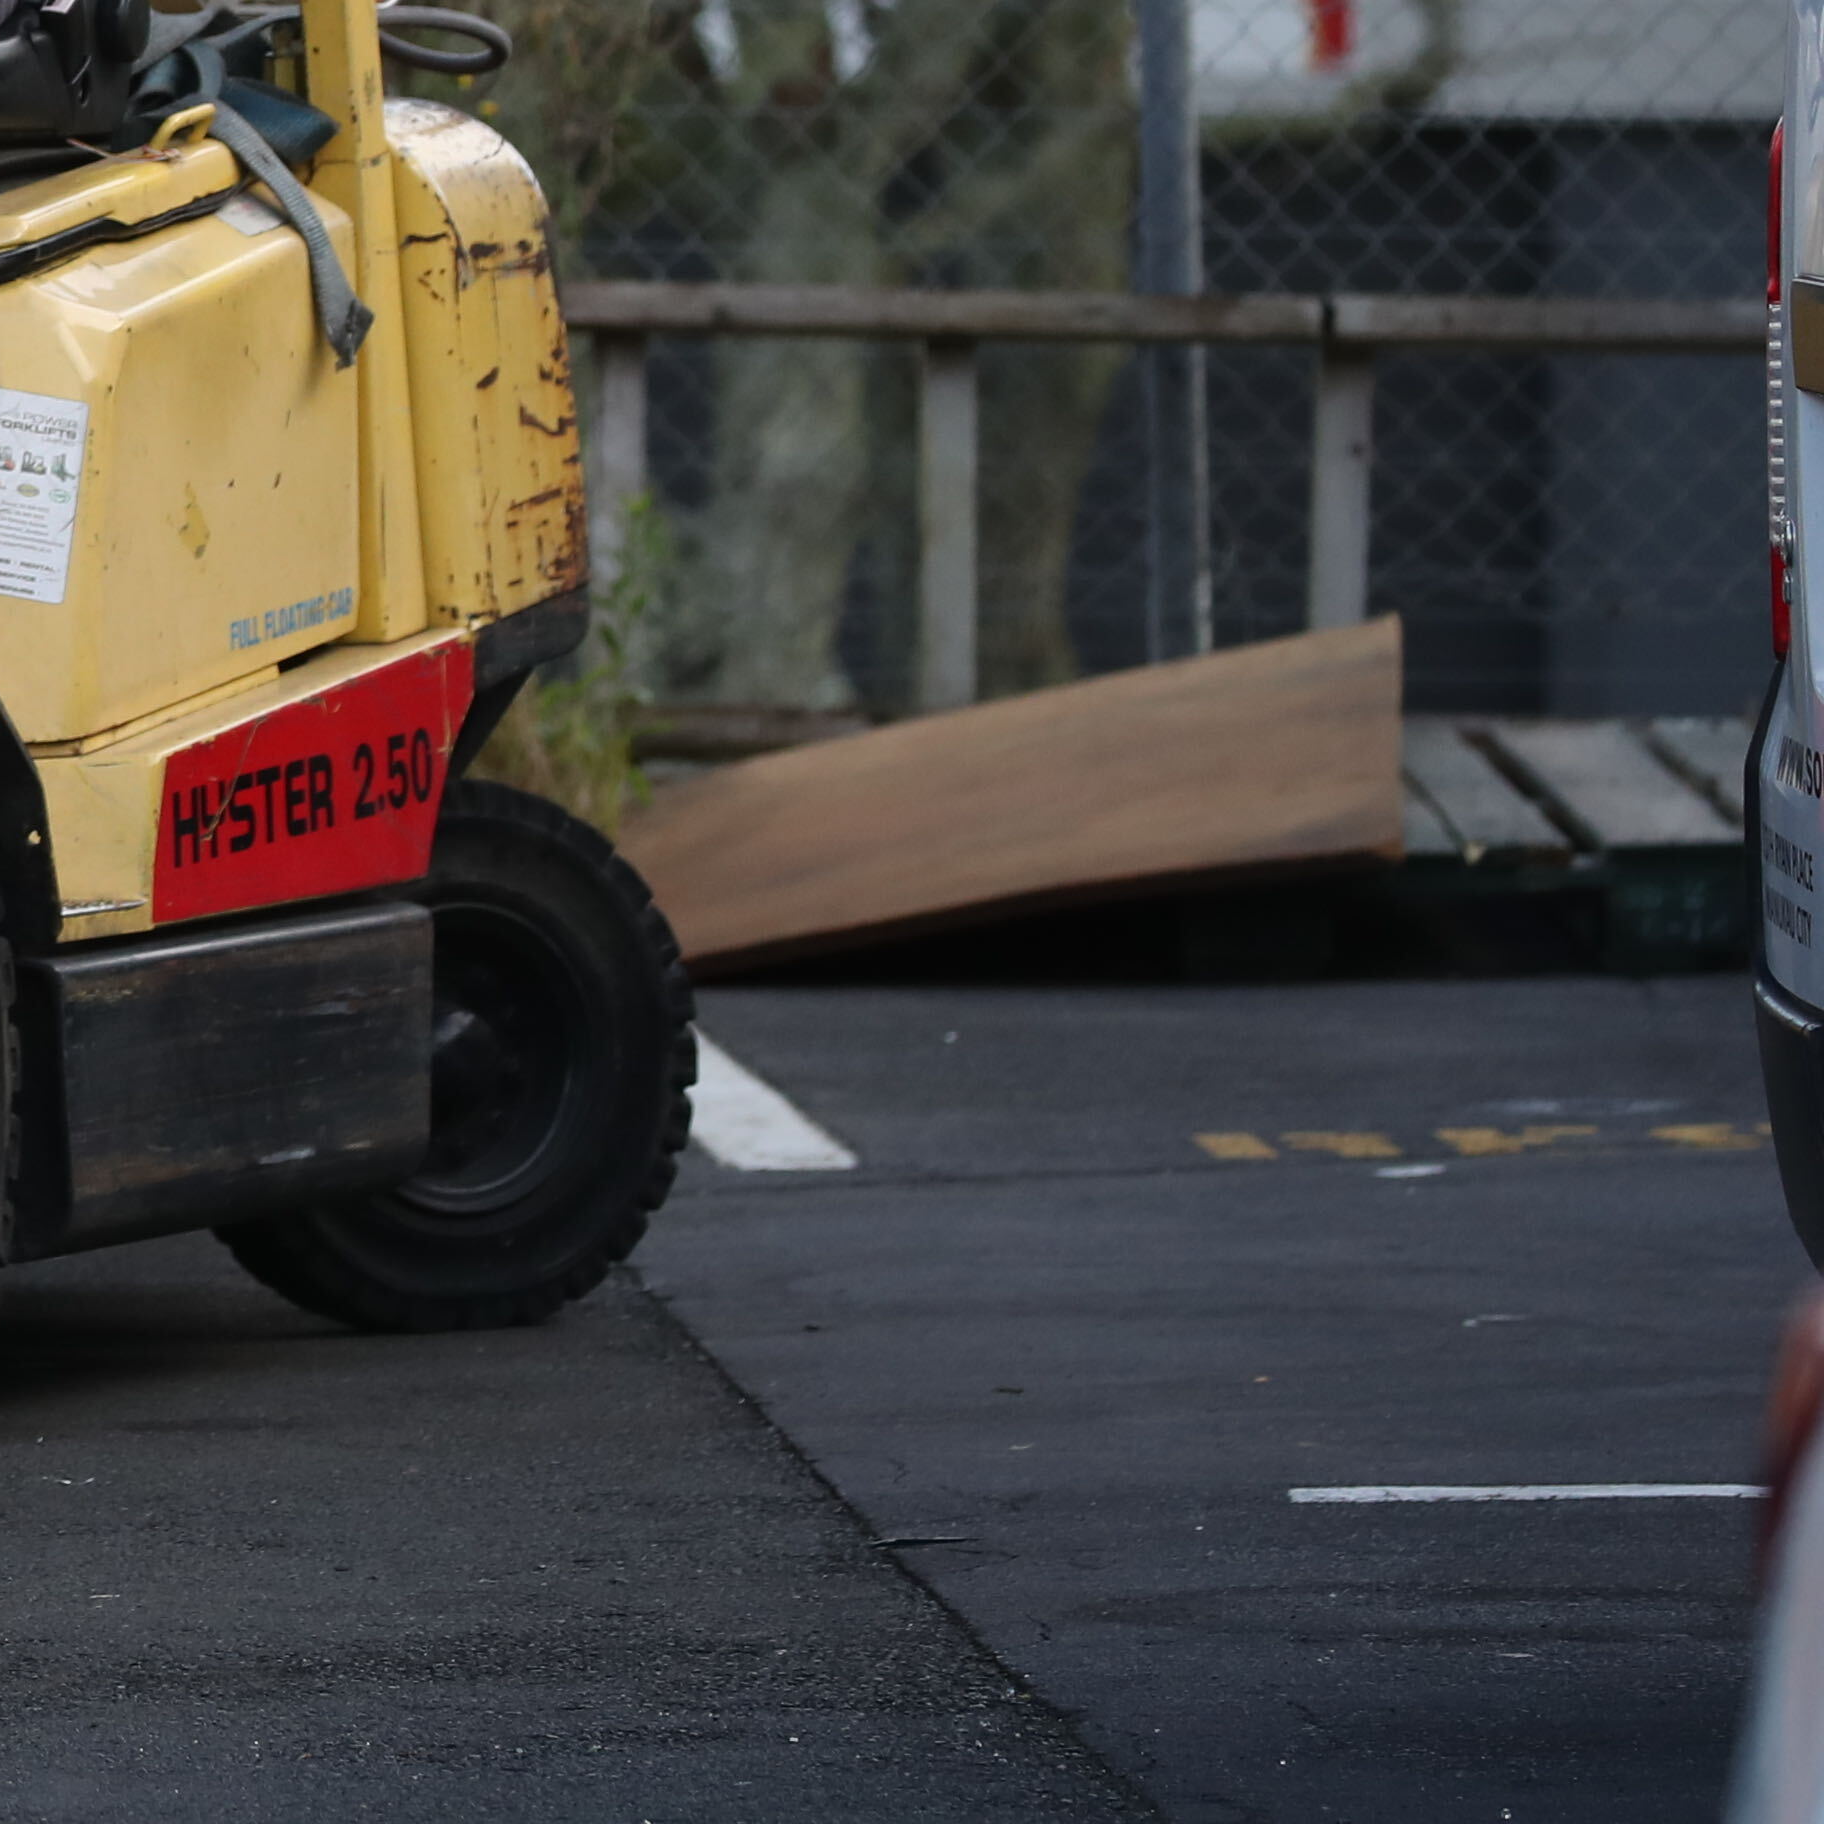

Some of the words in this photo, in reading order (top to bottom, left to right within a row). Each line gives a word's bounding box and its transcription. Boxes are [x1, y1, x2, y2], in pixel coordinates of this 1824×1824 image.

[22, 411, 79, 428] POWER
[230, 616, 260, 650] FULL
[264, 595, 324, 640] FLOATING
[328, 586, 352, 620] CAB
[172, 754, 335, 868] HYSTER
[353, 728, 433, 820] 2.50
[1796, 906, 1812, 949] CITY
